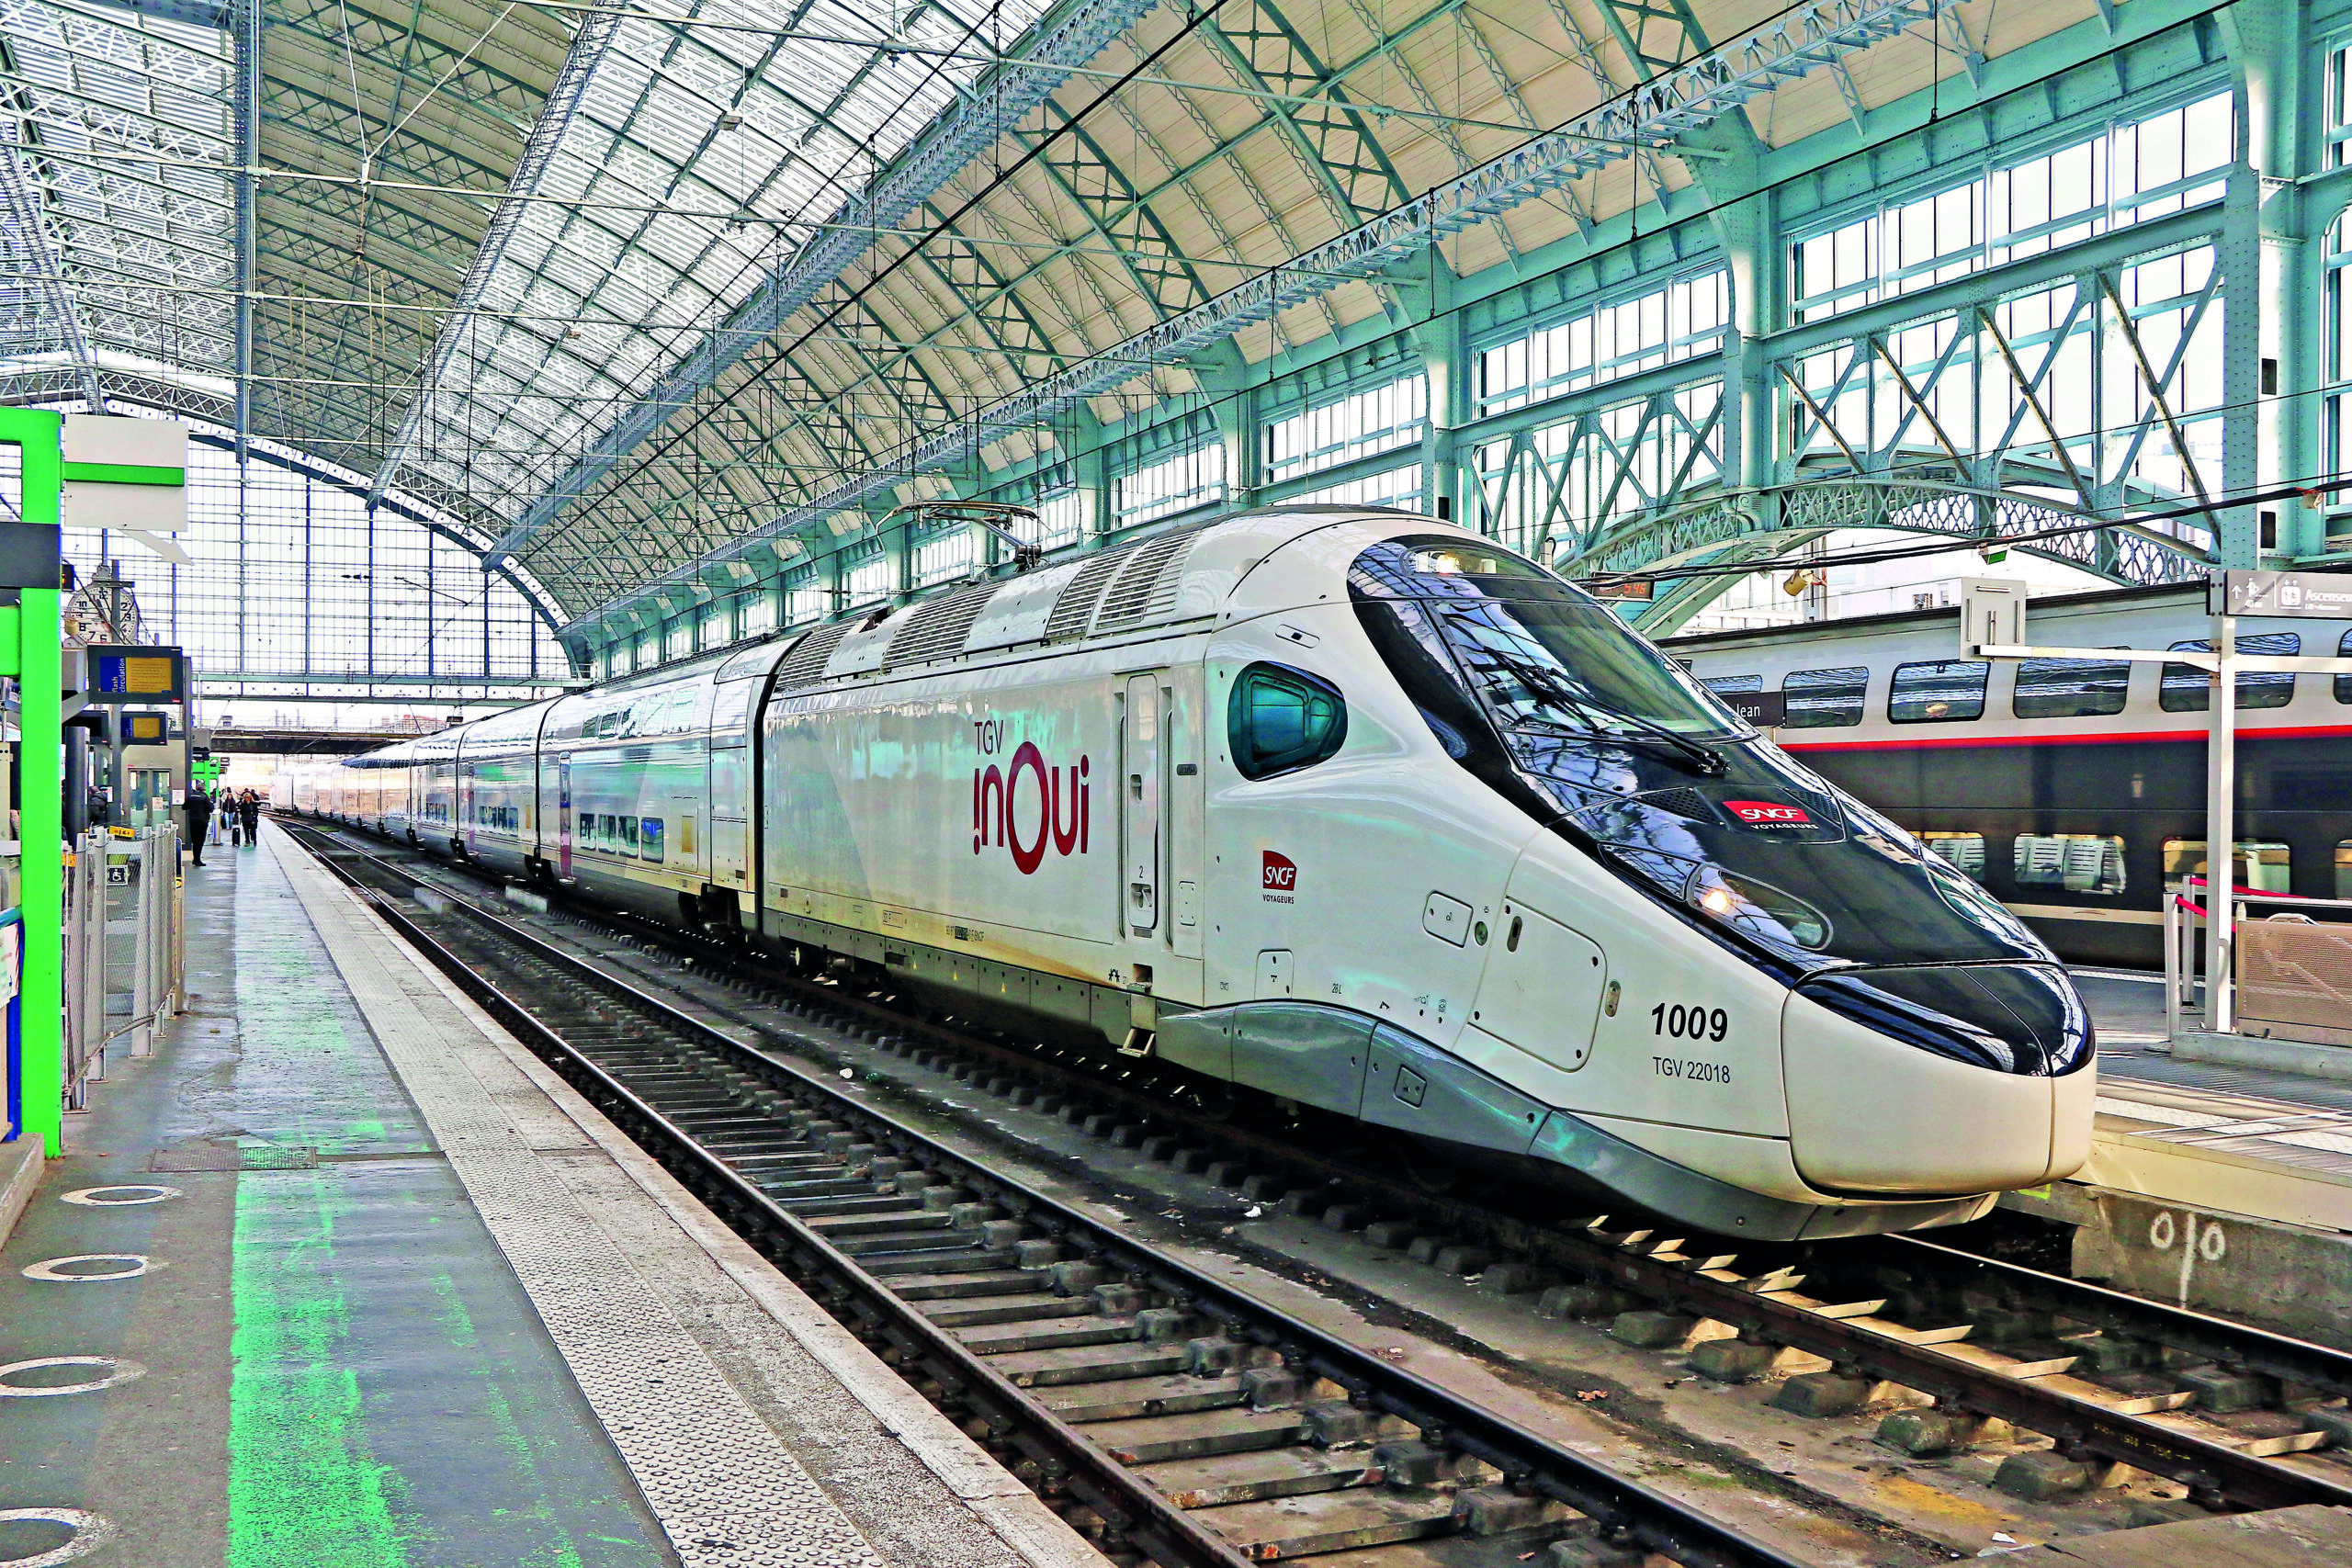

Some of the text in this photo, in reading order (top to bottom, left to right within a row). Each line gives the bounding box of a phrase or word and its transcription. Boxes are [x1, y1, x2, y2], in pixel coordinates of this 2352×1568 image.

[974, 719, 1004, 755] TGV
[1740, 808, 1799, 820] SNCF
[1138, 864, 1144, 879] 2
[1264, 865, 1295, 886] SNCF
[1262, 894, 1295, 905] VOYAGEURS
[1651, 1002, 1728, 1043] 1009
[1652, 1055, 1731, 1084] TGV 22018
